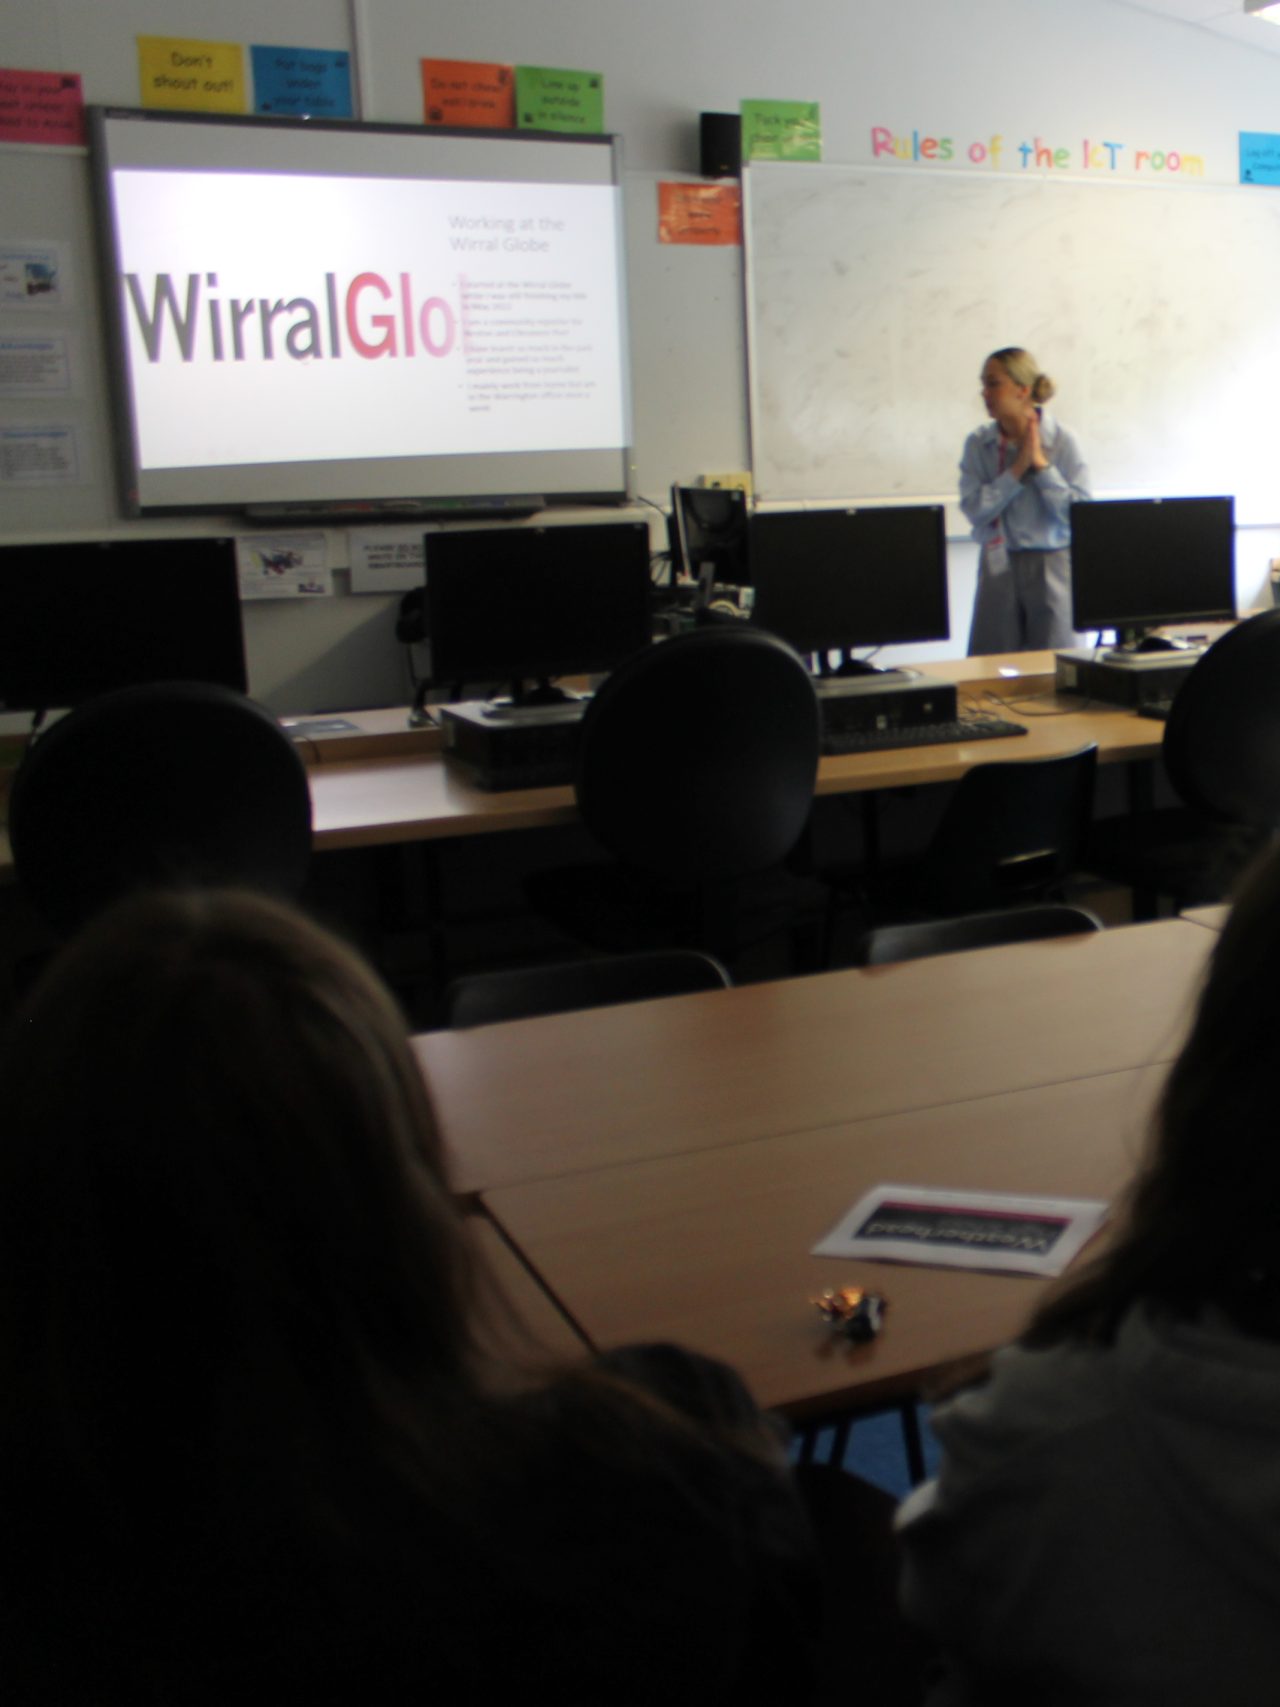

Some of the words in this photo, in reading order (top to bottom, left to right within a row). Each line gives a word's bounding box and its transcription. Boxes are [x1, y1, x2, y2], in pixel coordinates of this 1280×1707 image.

[171, 52, 213, 68] Don't
[154, 74, 198, 90] shout
[203, 79, 234, 92] out!
[871, 126, 954, 161] Rules
[968, 134, 1004, 171] of
[1017, 137, 1071, 169] the
[1135, 149, 1205, 176] room
[449, 215, 515, 232] Working
[520, 218, 534, 231] at
[538, 217, 565, 231] the
[449, 237, 498, 251] Wirral
[502, 236, 549, 251] Globe
